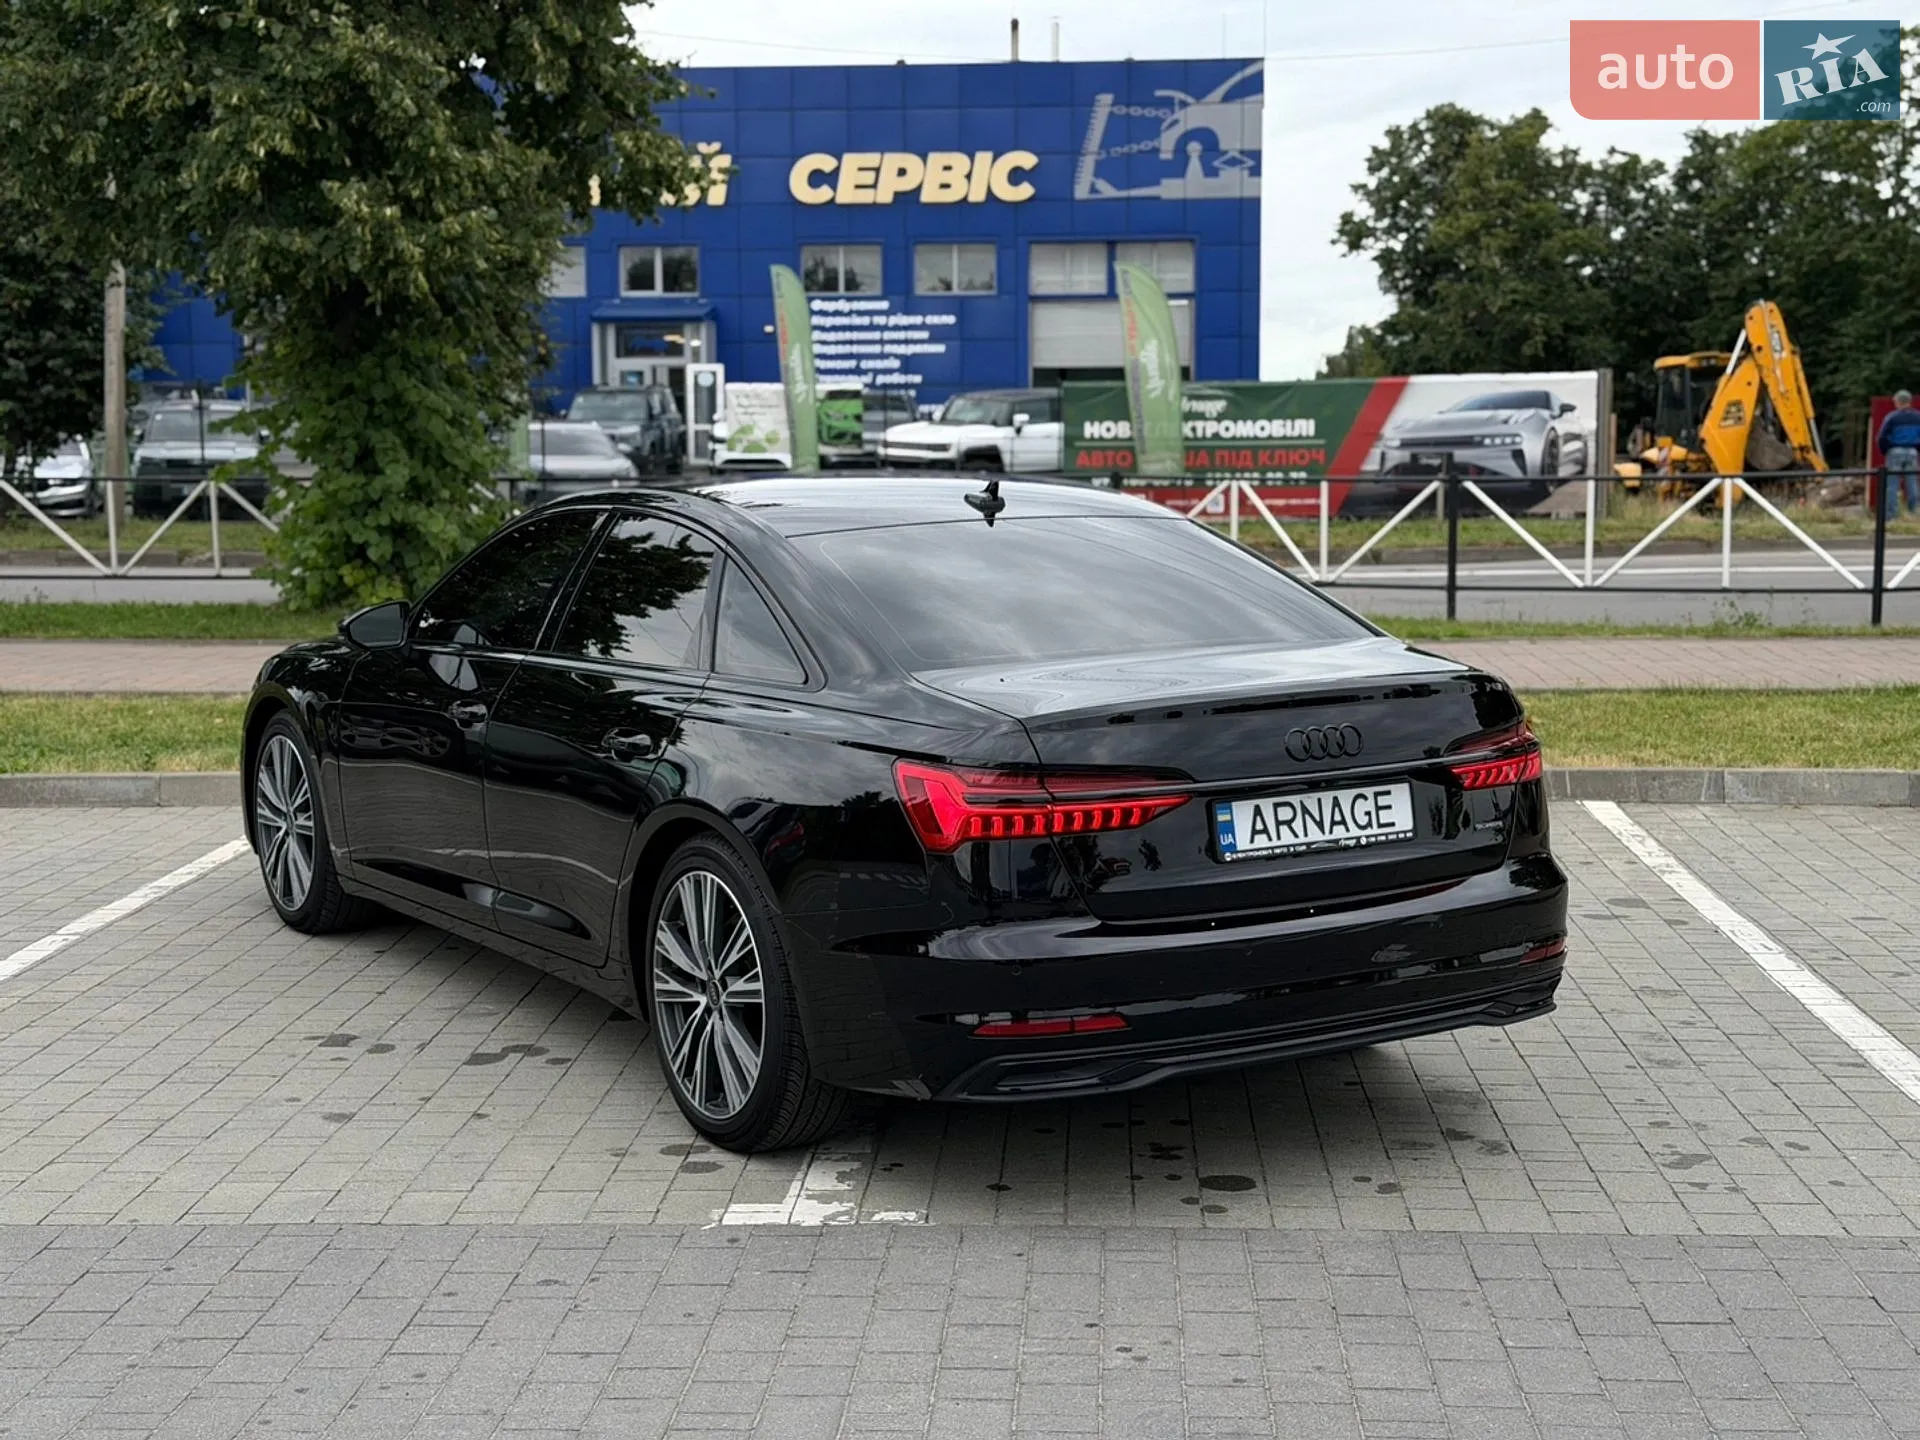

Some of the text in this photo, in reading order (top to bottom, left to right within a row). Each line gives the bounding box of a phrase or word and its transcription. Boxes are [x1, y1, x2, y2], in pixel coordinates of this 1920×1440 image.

[789, 150, 1039, 204] СЕРВІС
[1084, 421, 1132, 439] НОВ
[1076, 450, 1134, 468] АВТО
[1216, 449, 1253, 468] ПІД
[1258, 449, 1326, 467] КЛЮЧ
[1249, 790, 1396, 844] ARNAGE
[1220, 833, 1235, 845] UA
